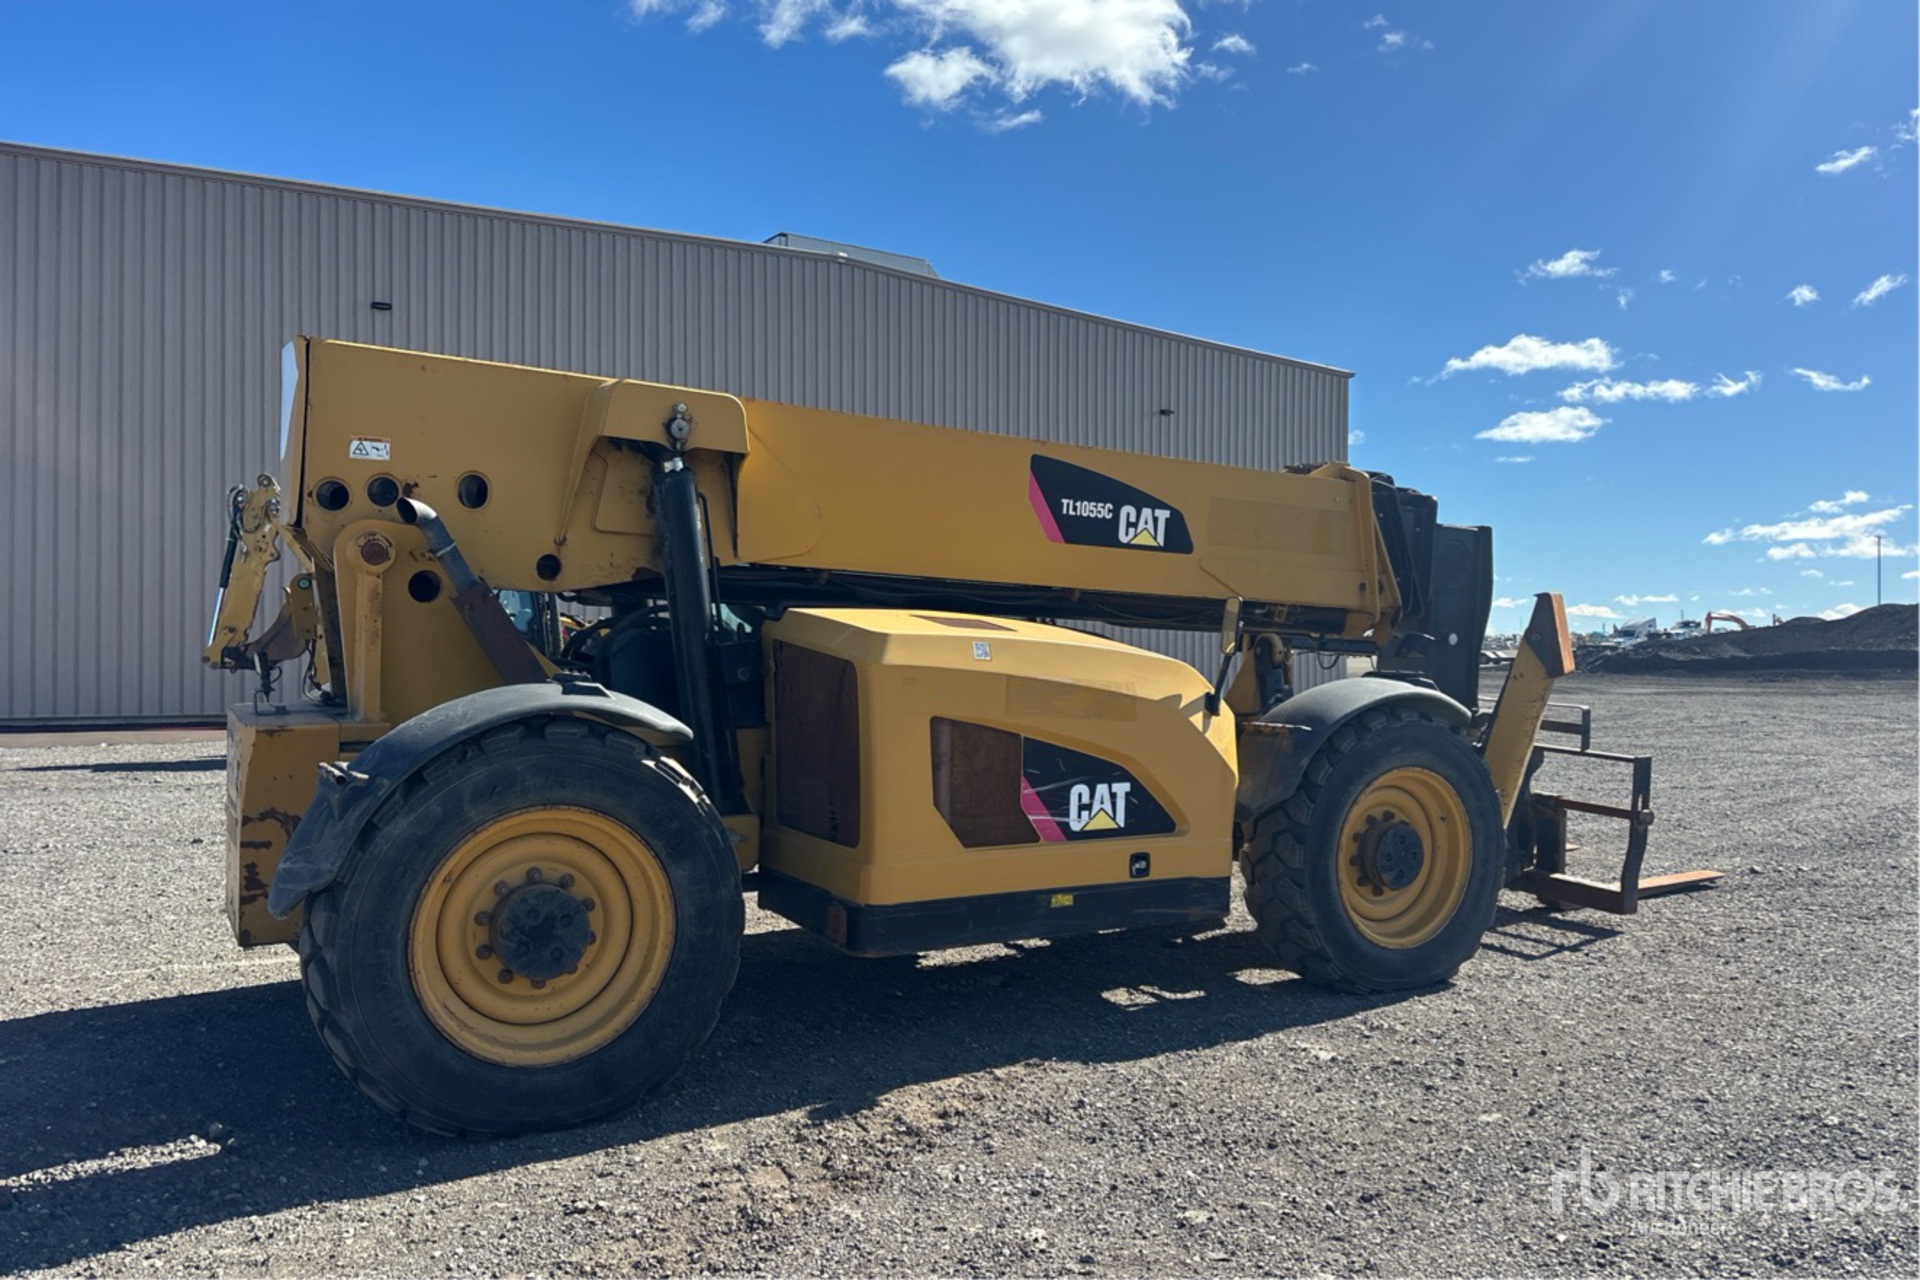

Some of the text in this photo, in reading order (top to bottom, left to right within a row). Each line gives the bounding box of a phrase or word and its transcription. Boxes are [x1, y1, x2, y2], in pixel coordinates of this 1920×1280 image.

[1061, 499, 1170, 547] TL1055C CAT
[1069, 782, 1130, 831] CAT
